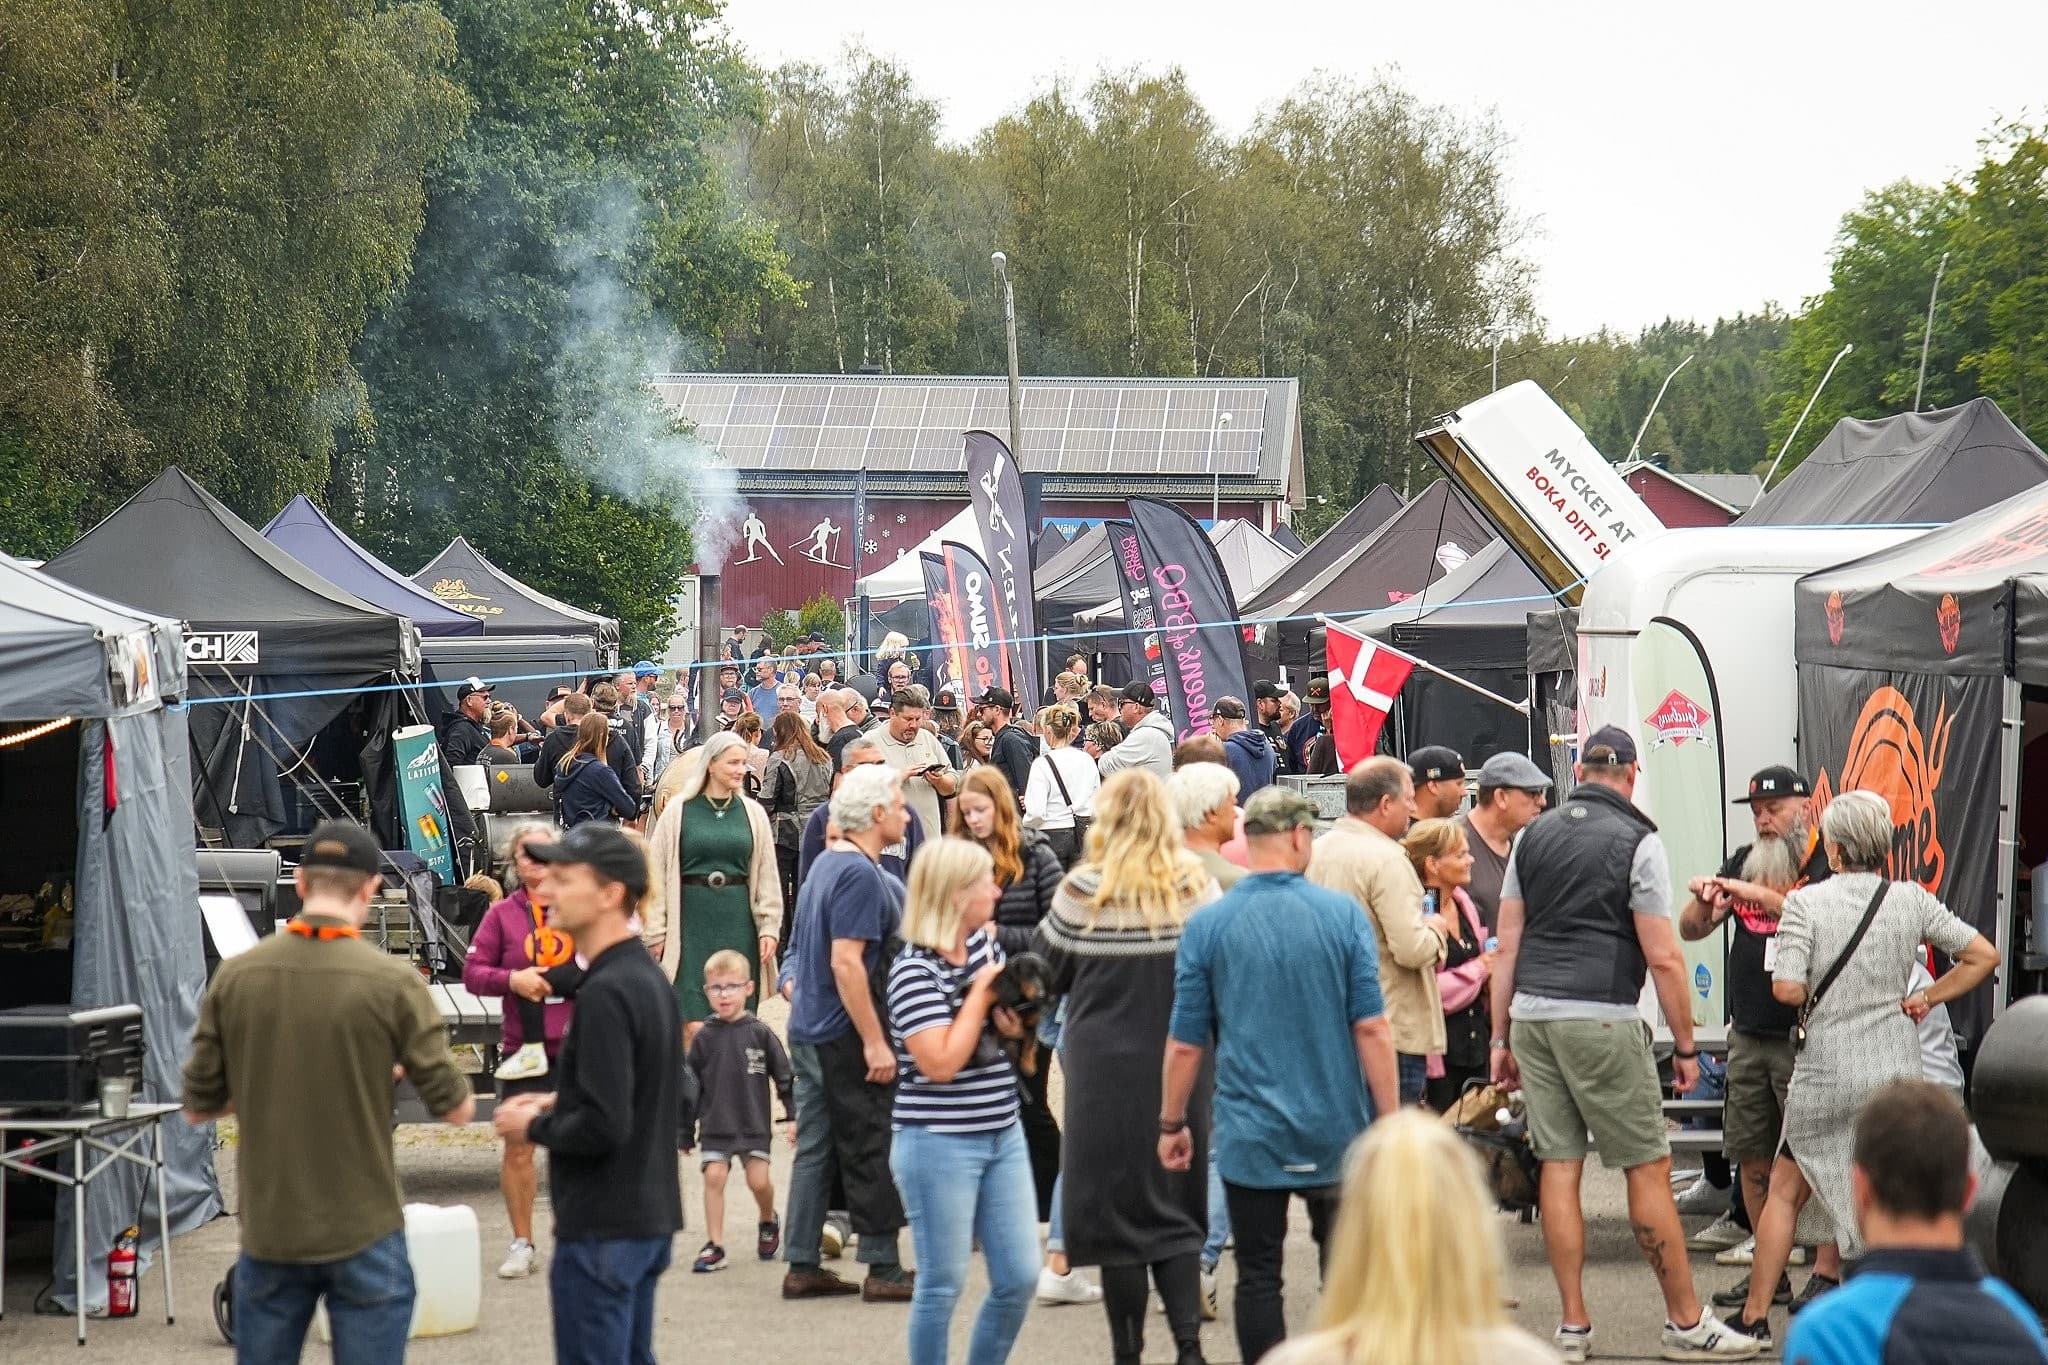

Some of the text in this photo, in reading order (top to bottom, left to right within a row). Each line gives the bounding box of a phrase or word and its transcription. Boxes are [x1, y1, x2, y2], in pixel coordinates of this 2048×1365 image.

[1526, 466, 1566, 512] BOKA
[1565, 510, 1597, 542] DITT
[1544, 448, 1613, 518] MYCKET
